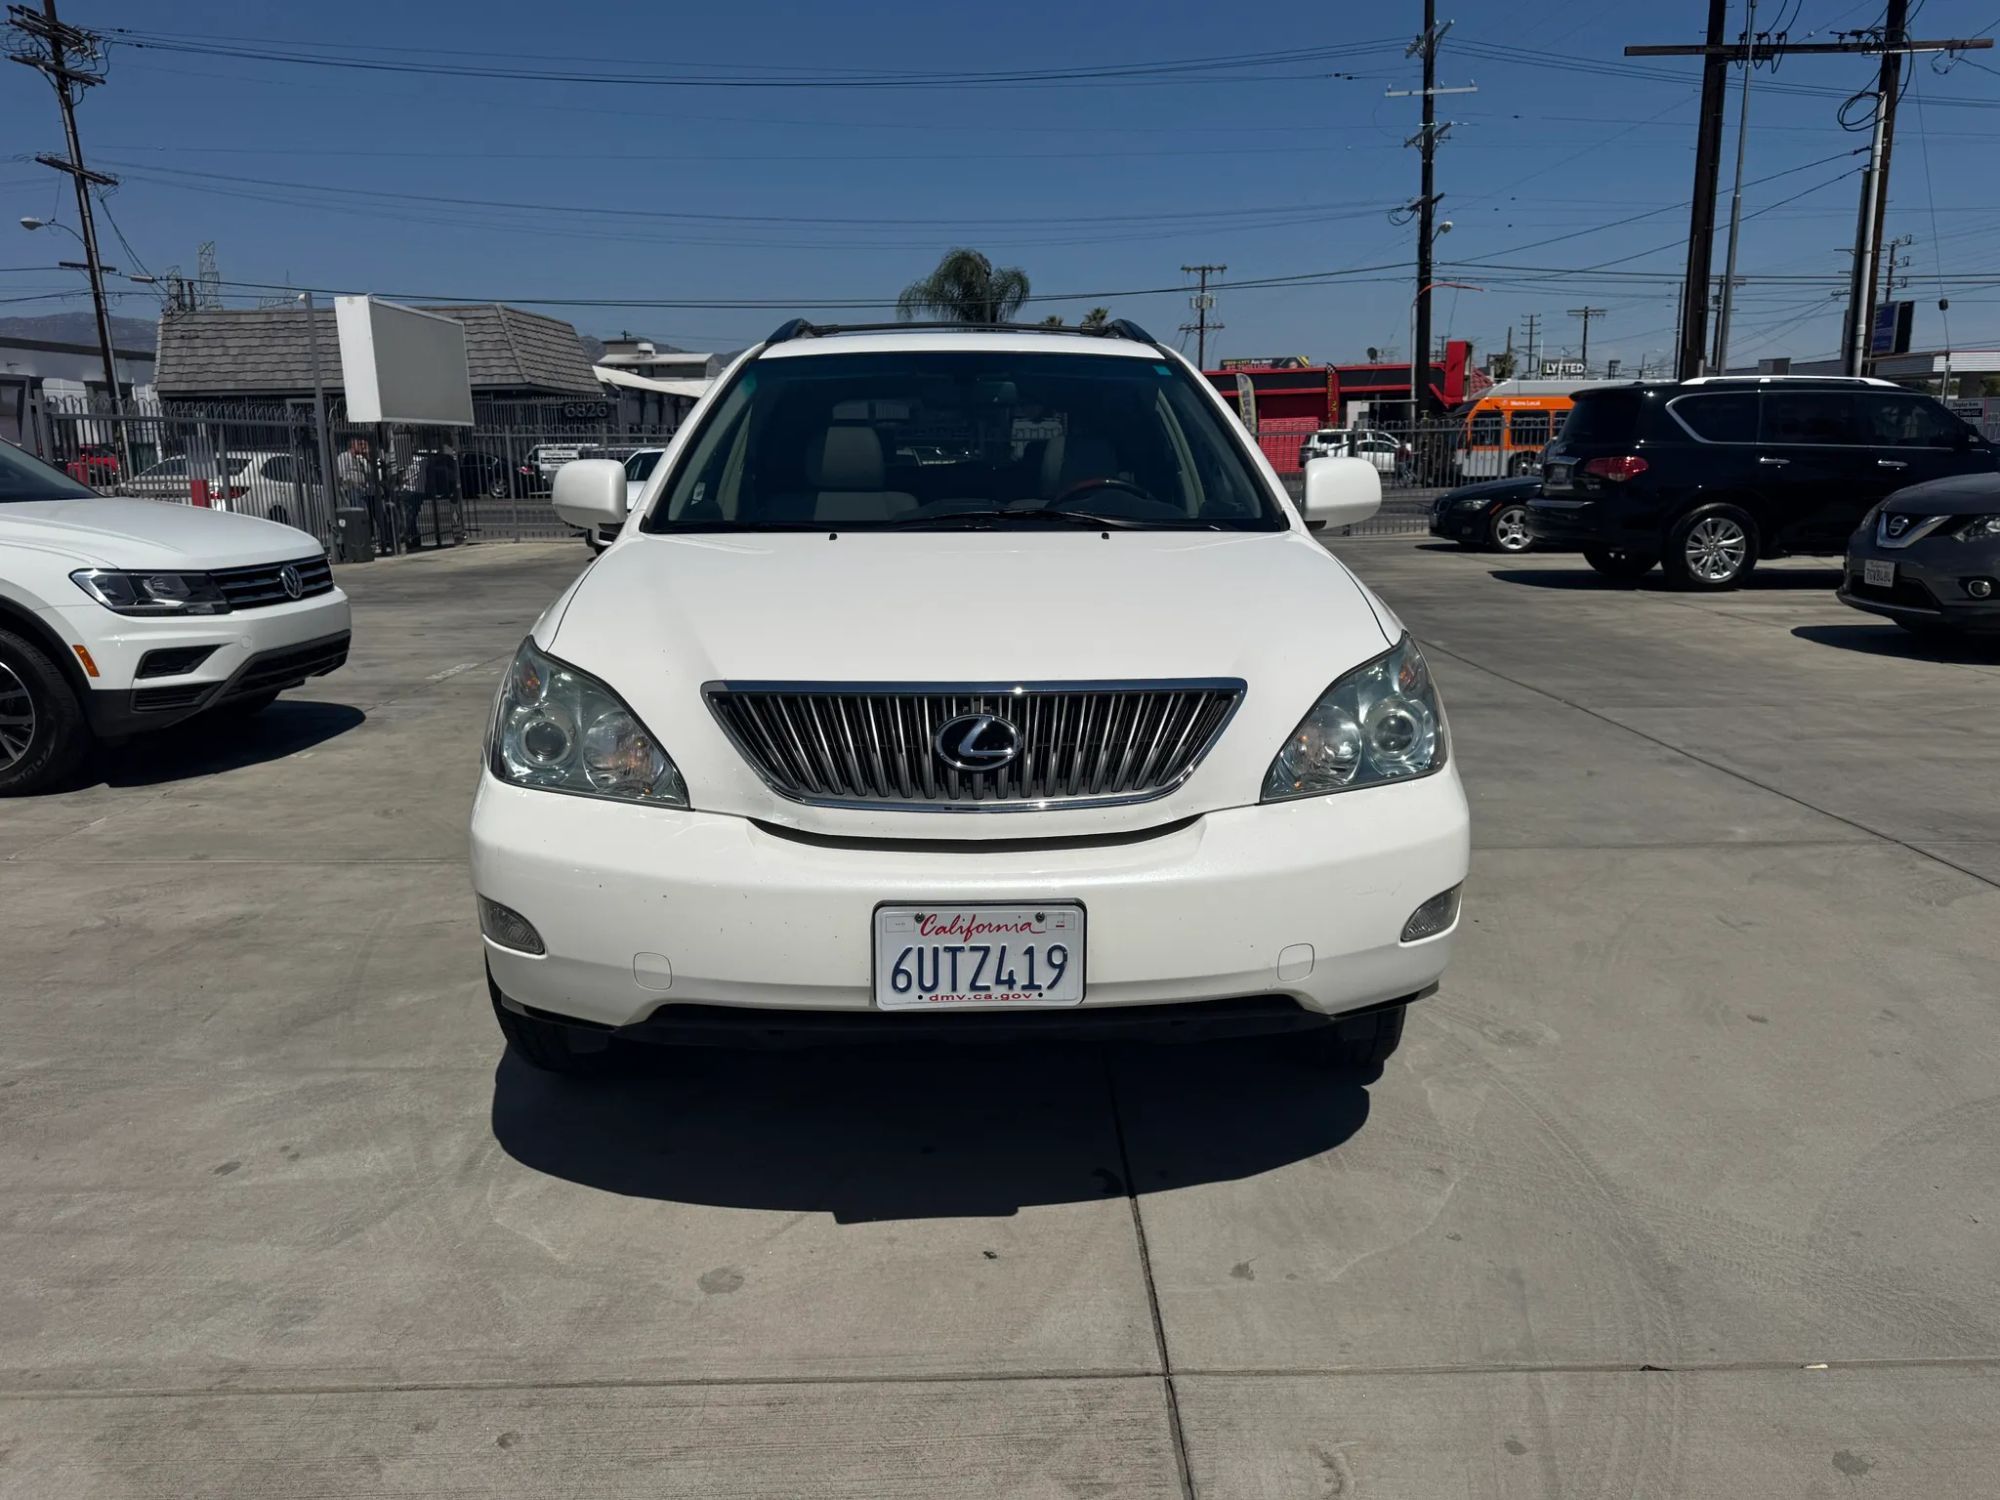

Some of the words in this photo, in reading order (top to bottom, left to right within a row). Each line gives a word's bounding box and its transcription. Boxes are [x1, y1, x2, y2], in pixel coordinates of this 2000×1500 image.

[1546, 363, 1584, 373] LYFTED
[565, 402, 608, 417] 6826
[919, 913, 1046, 942] California
[890, 943, 1069, 993] 6UTZ419
[928, 992, 1034, 1002] dmv.ca.gov
